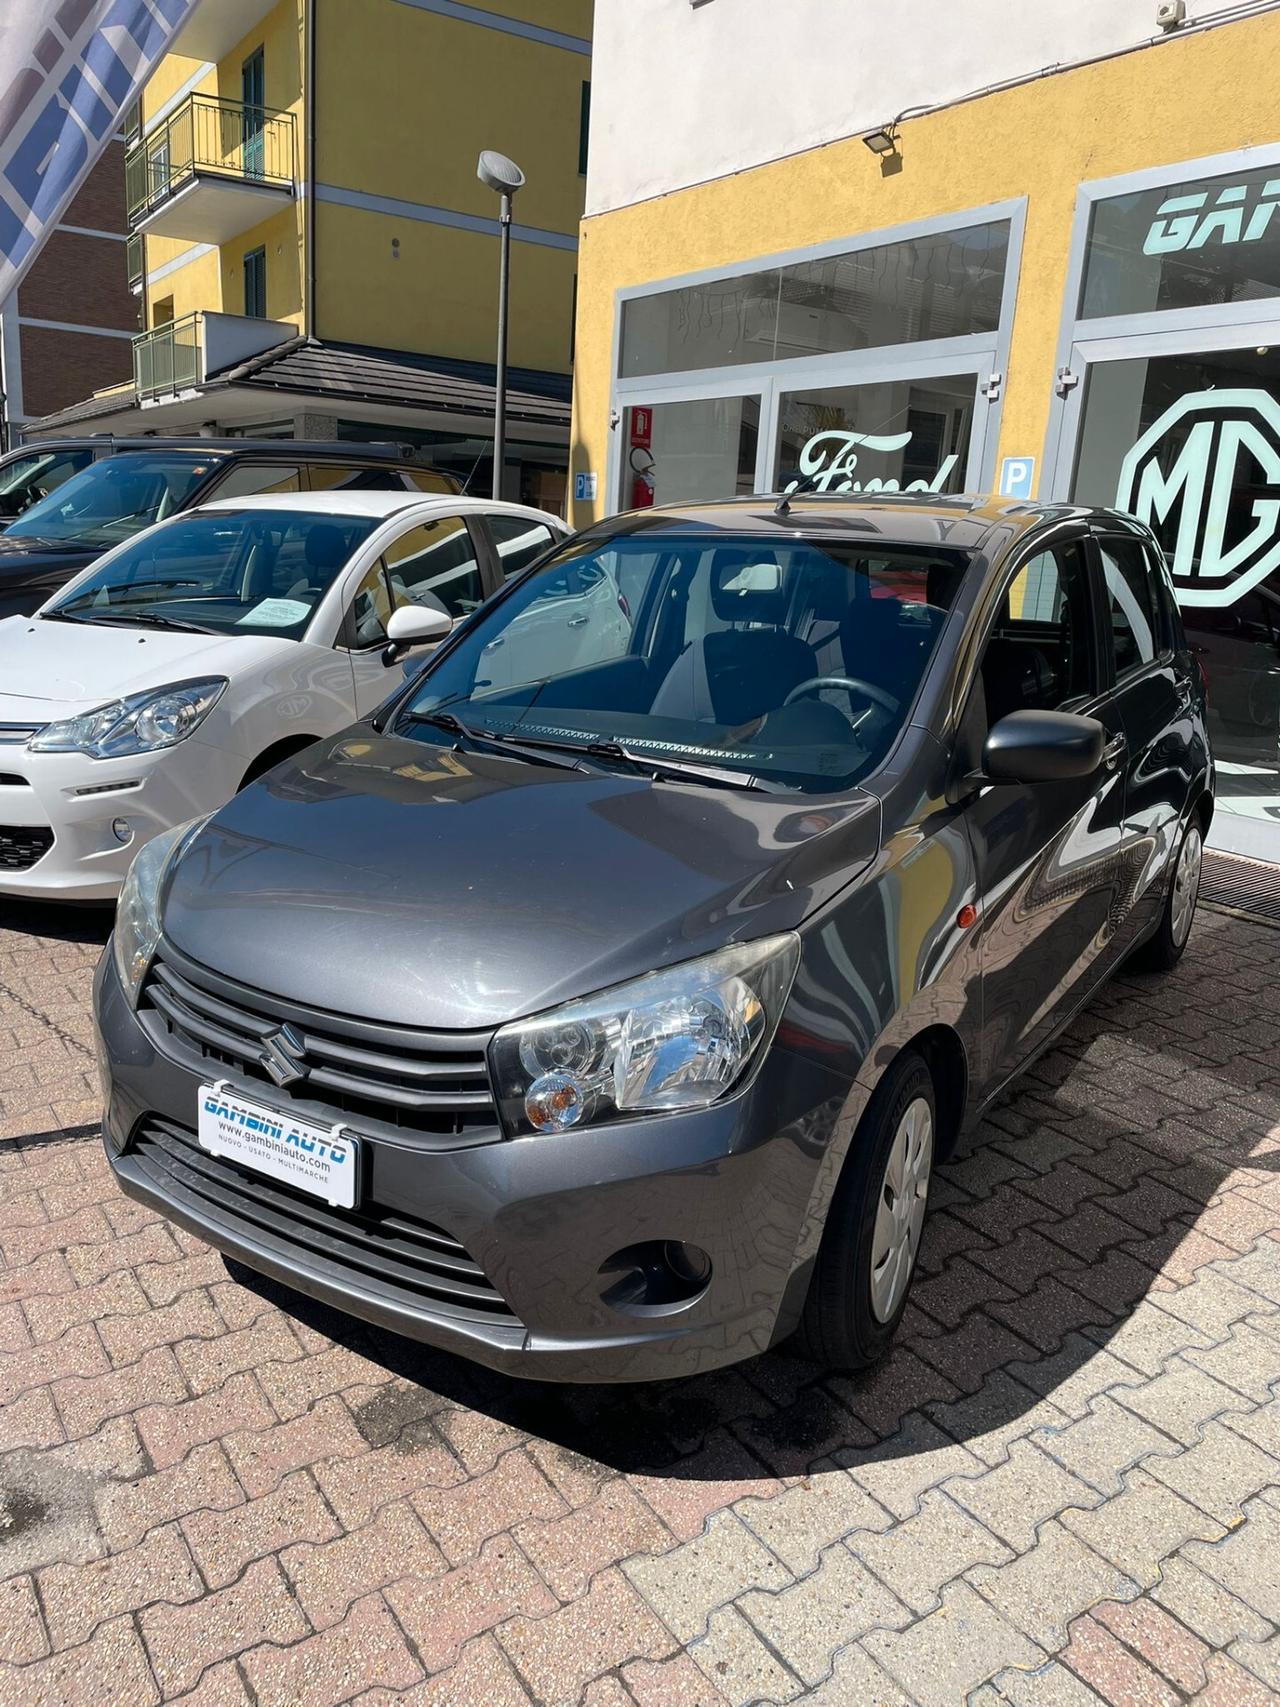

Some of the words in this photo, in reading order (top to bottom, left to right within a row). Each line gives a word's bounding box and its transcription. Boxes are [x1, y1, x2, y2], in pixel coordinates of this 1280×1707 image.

[1005, 462, 1027, 495] P
[1135, 420, 1280, 577] MG
[204, 1096, 284, 1140] GAMBINI
[286, 1128, 347, 1164] AUTO
[219, 1121, 331, 1174] www.gambiniauto.com
[218, 1134, 242, 1148] NUOVO
[248, 1146, 271, 1160] USATO
[278, 1158, 329, 1184] MULTIMARCHE
